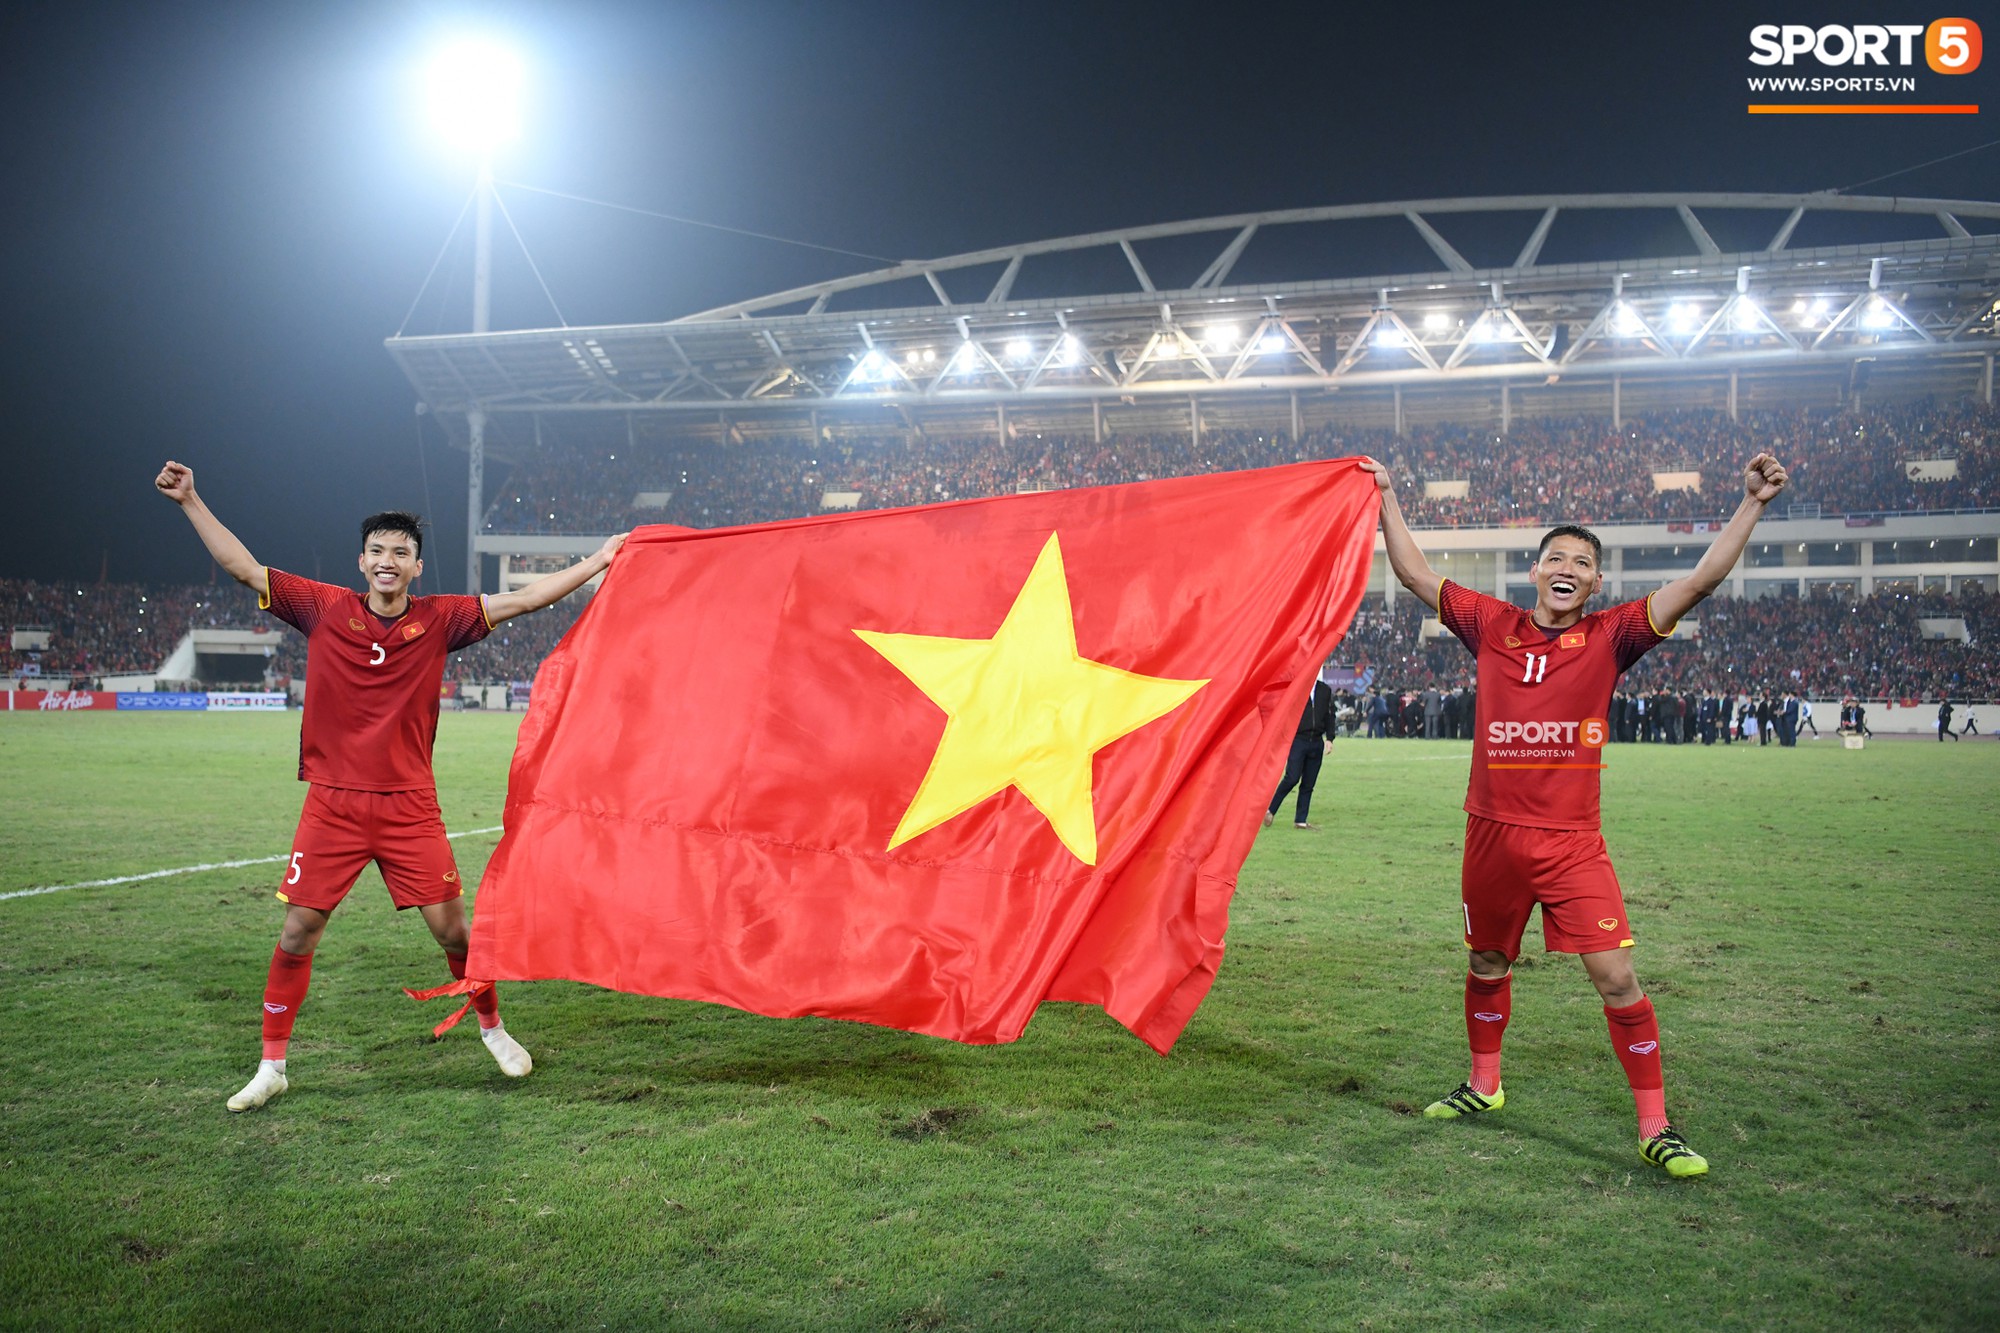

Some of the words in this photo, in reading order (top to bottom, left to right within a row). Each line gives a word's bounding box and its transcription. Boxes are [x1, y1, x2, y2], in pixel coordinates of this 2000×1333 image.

[369, 642, 386, 665] 5
[1522, 652, 1547, 683] 11
[287, 851, 304, 885] 5
